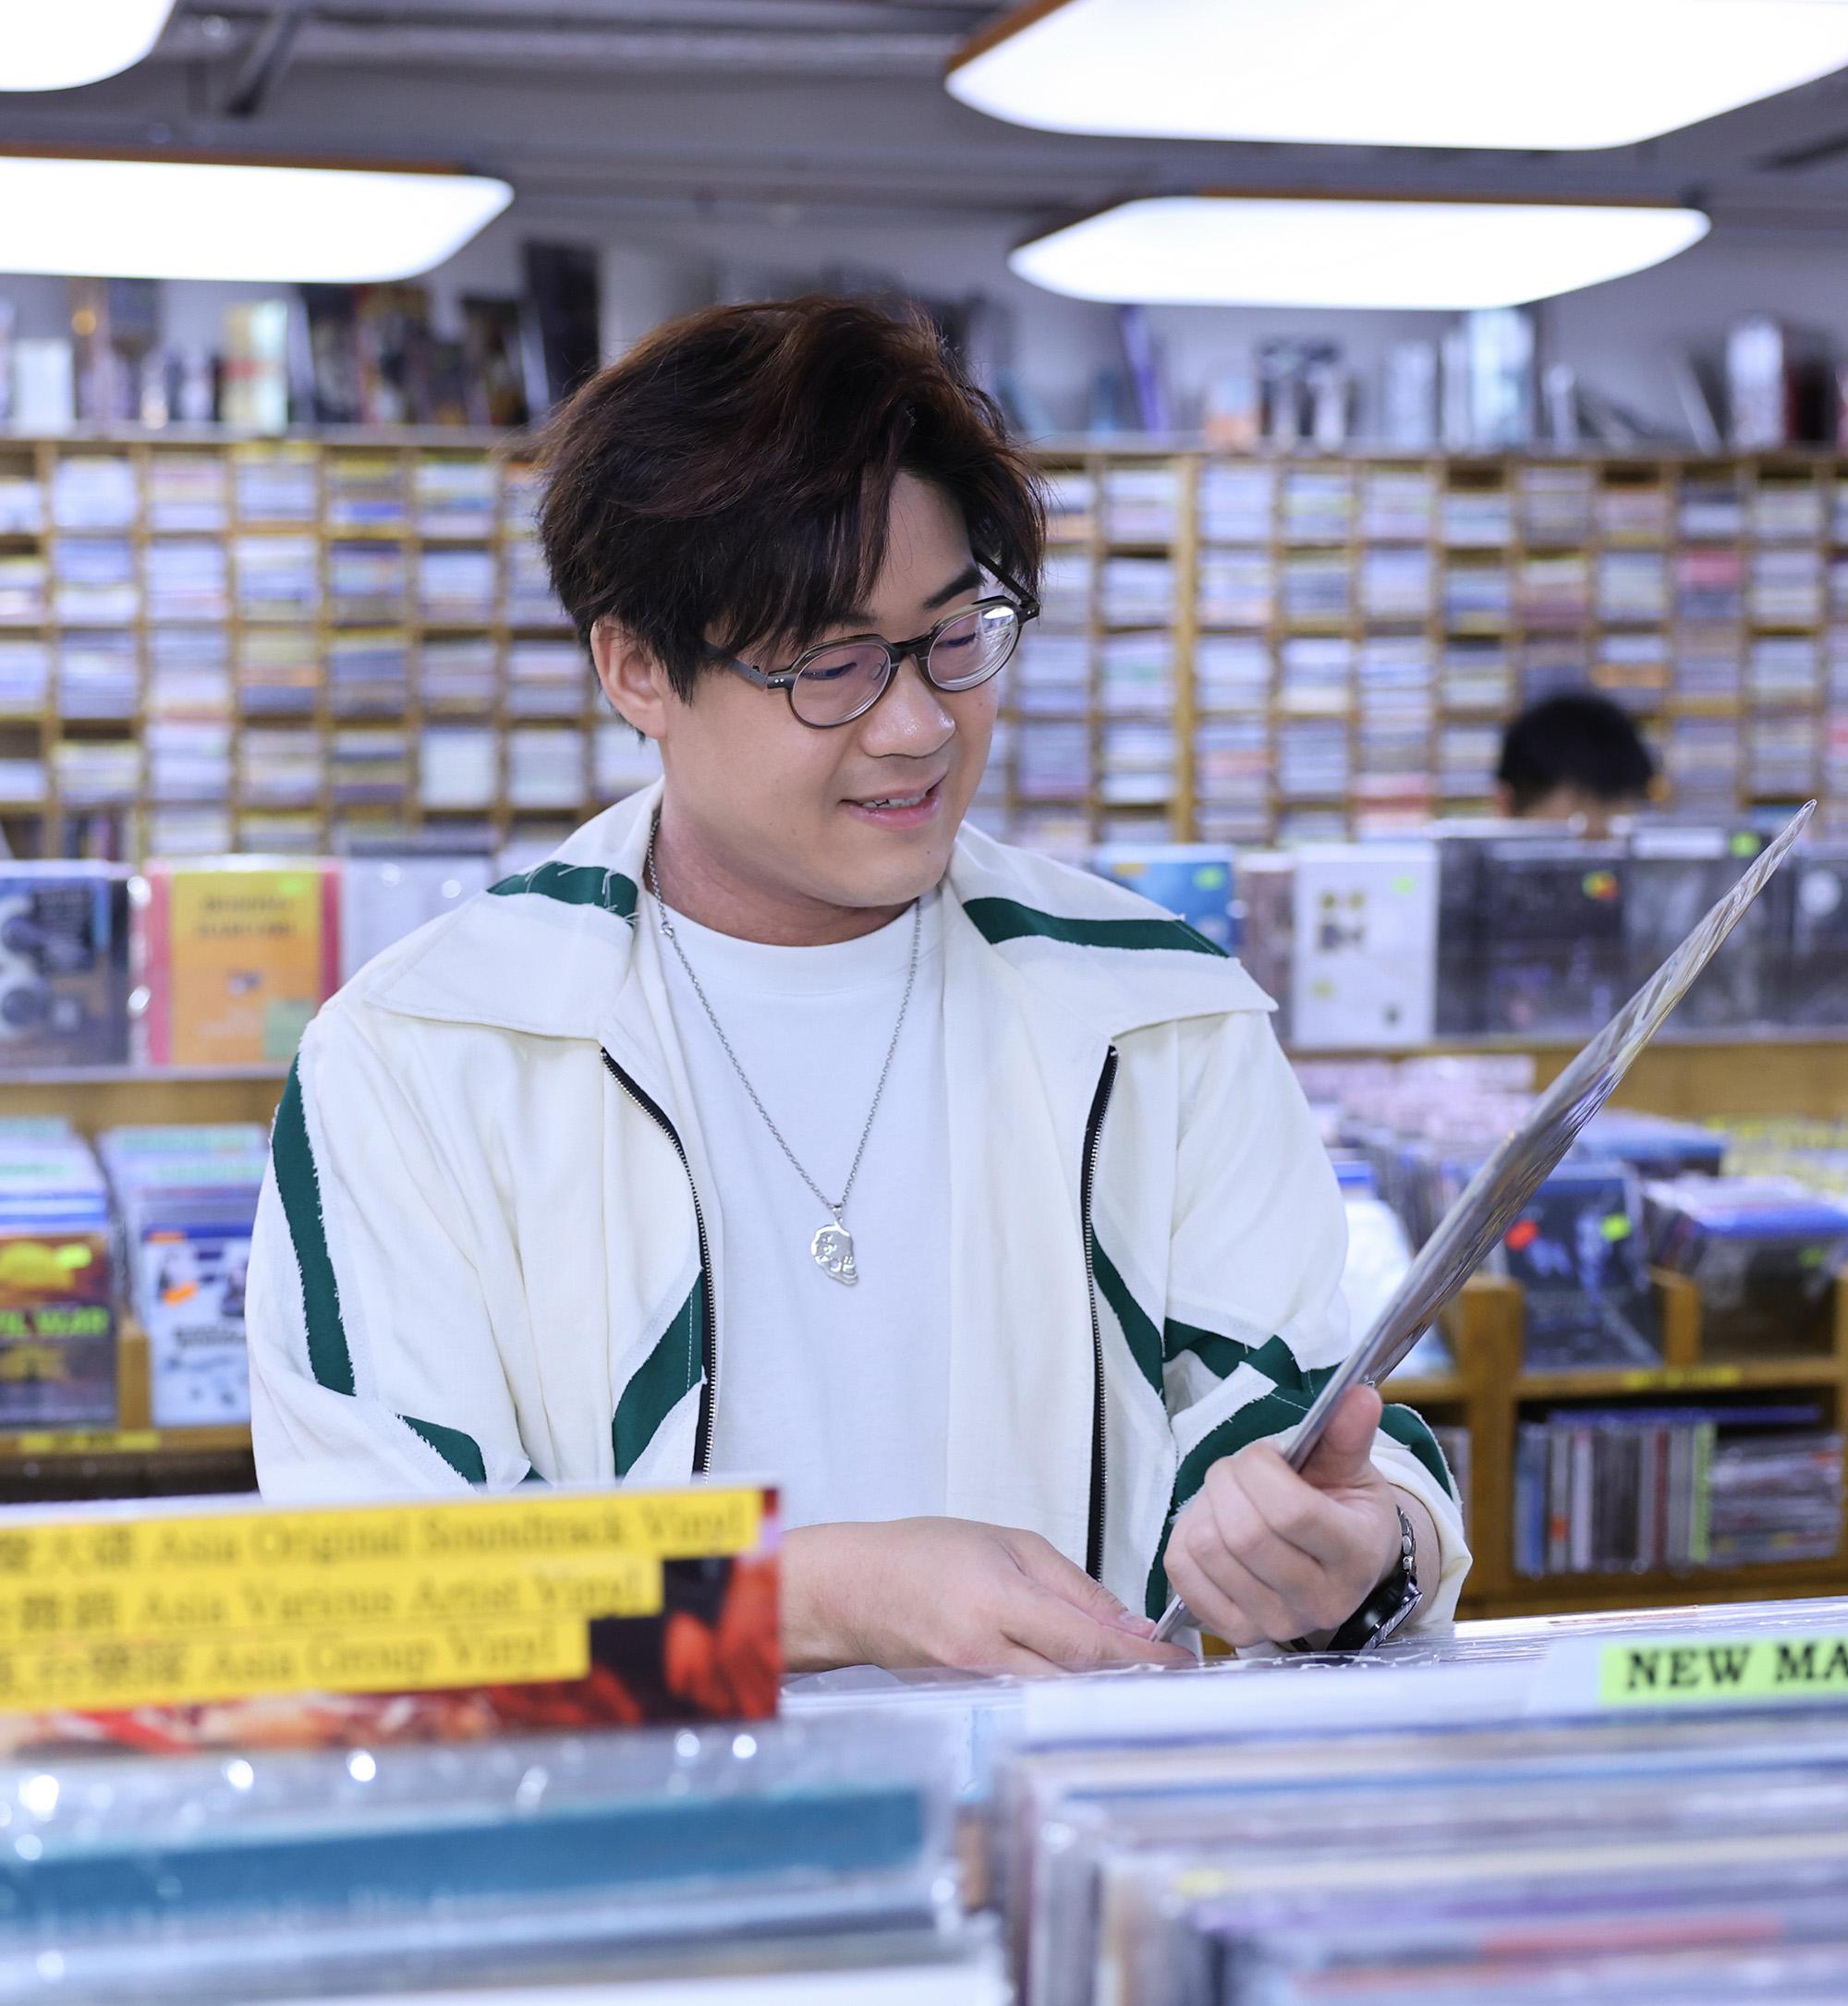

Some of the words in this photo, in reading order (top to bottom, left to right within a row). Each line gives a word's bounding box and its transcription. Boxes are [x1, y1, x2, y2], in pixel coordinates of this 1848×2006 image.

[153, 1525, 237, 1563] Asia
[250, 1512, 407, 1568] Original
[425, 1503, 623, 1550] Soundtrack
[641, 1496, 740, 1546] Vinyl
[140, 1587, 225, 1625] Asia
[239, 1577, 394, 1622] Various
[407, 1569, 520, 1613] Artist
[532, 1561, 642, 1611] Vinyl
[211, 1643, 294, 1680] Asia
[305, 1630, 434, 1682] Group
[446, 1621, 552, 1672] Vinyl
[1627, 1646, 1750, 1690] NEW
[1775, 1640, 1848, 1682] MA
